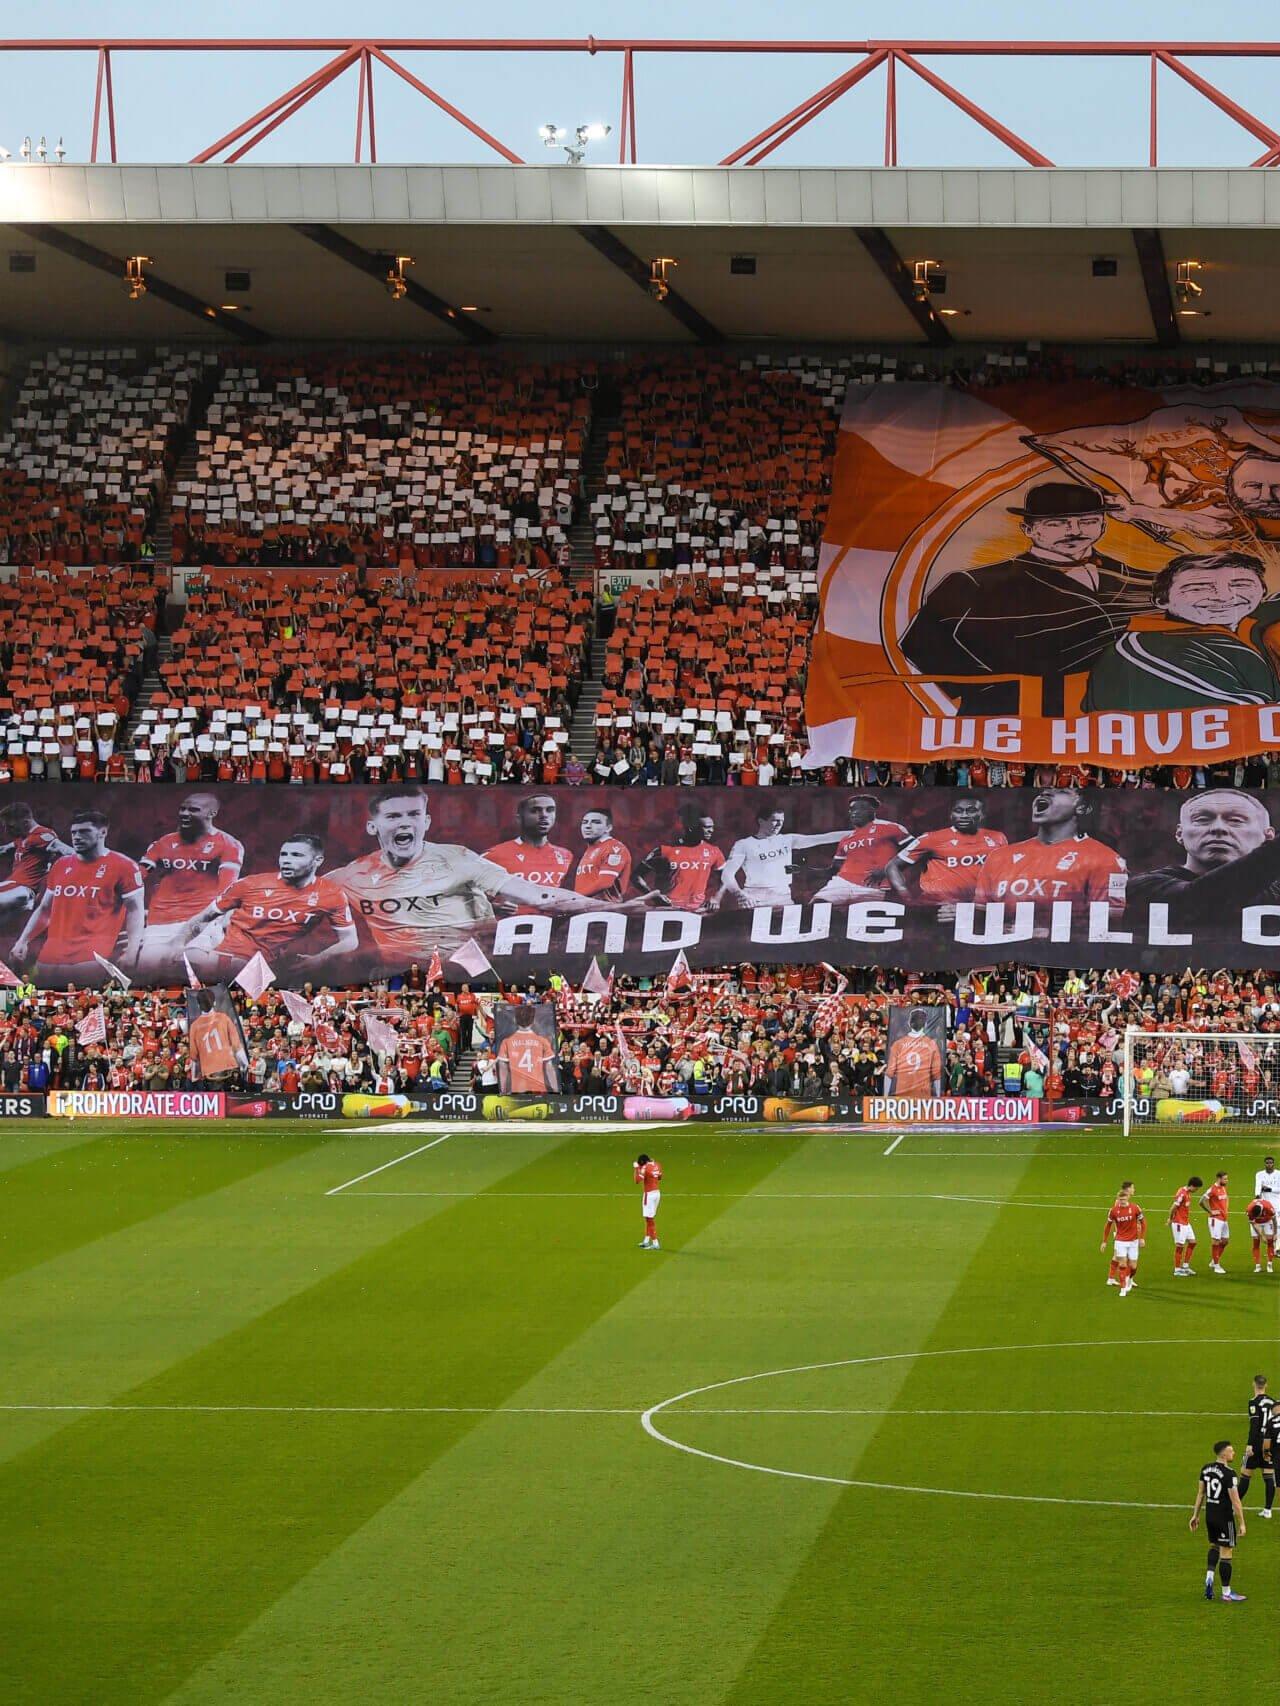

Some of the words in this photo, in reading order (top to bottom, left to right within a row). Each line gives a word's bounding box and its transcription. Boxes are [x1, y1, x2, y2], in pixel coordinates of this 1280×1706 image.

[611, 576, 630, 586] EXIT
[920, 716, 1023, 754] WE
[1051, 707, 1231, 755] HAVE
[843, 837, 875, 853] BOXT
[162, 857, 212, 873] BOXT
[670, 860, 712, 872] BOXT
[947, 854, 987, 868] BOX
[53, 884, 101, 899] BOXT
[997, 878, 1068, 898] BOXT
[359, 893, 443, 916] BOXT
[252, 906, 316, 924] BOXT
[493, 910, 703, 955] AND
[750, 901, 906, 944] WE
[954, 900, 1193, 946] WILL
[201, 1027, 223, 1053] 11
[518, 1048, 534, 1073] 4
[905, 1051, 922, 1072] 9
[869, 1098, 1033, 1122] iPROHYDRATE.COM
[1203, 1475, 1222, 1499] 19
